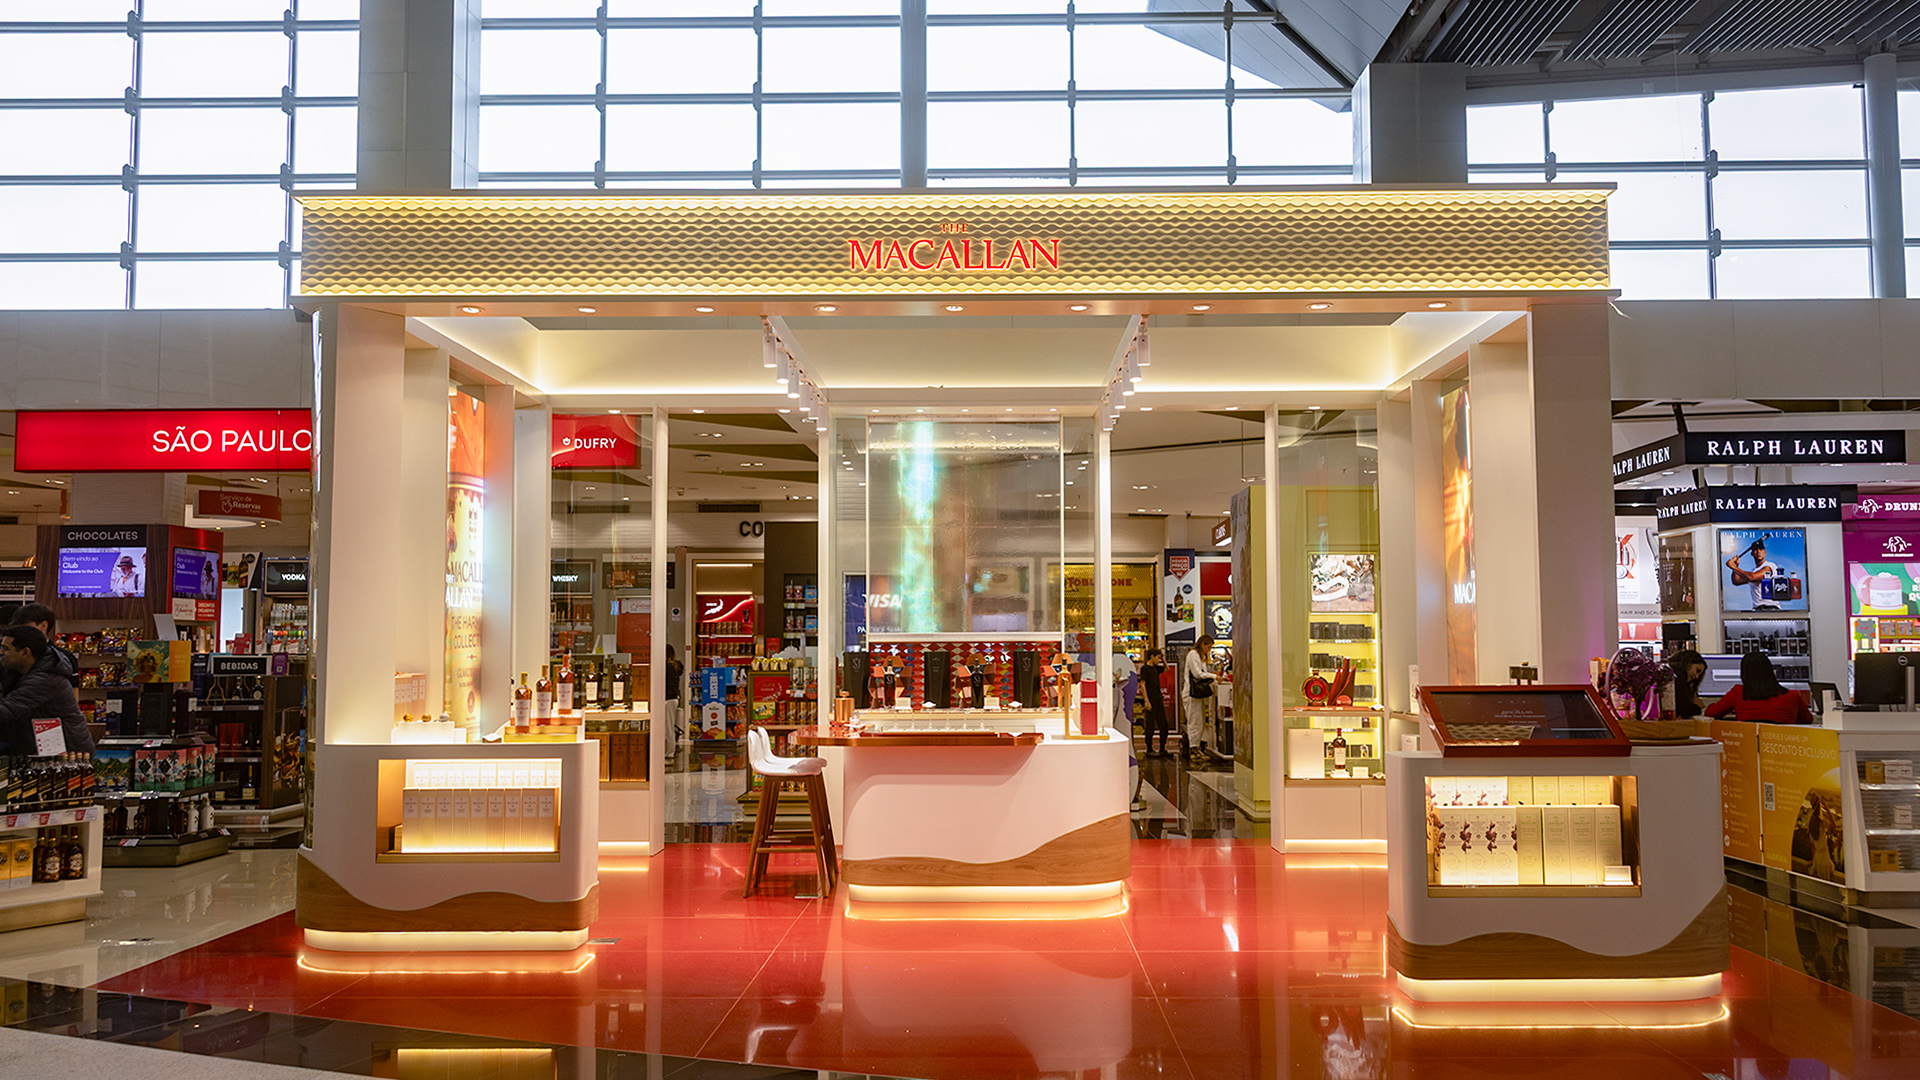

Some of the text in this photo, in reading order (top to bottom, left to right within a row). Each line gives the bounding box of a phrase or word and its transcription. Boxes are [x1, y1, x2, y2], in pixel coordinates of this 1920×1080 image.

[940, 223, 969, 233] THE
[848, 239, 1060, 271] MACALLAN
[153, 426, 312, 452] SÃO PAULO
[575, 438, 617, 449] DUFRY
[1707, 440, 1884, 456] RALPH LAUREN
[1636, 446, 1670, 470] LAUREN
[1658, 500, 1708, 518] RALPH LAUREN
[1716, 498, 1838, 509] RALPH LAUREN
[1885, 502, 1920, 511] DRUN
[68, 532, 138, 540] CHOCOLATES
[862, 594, 902, 608] VISA
[1762, 742, 1836, 760] DESCONTO EXCLUSIVO
